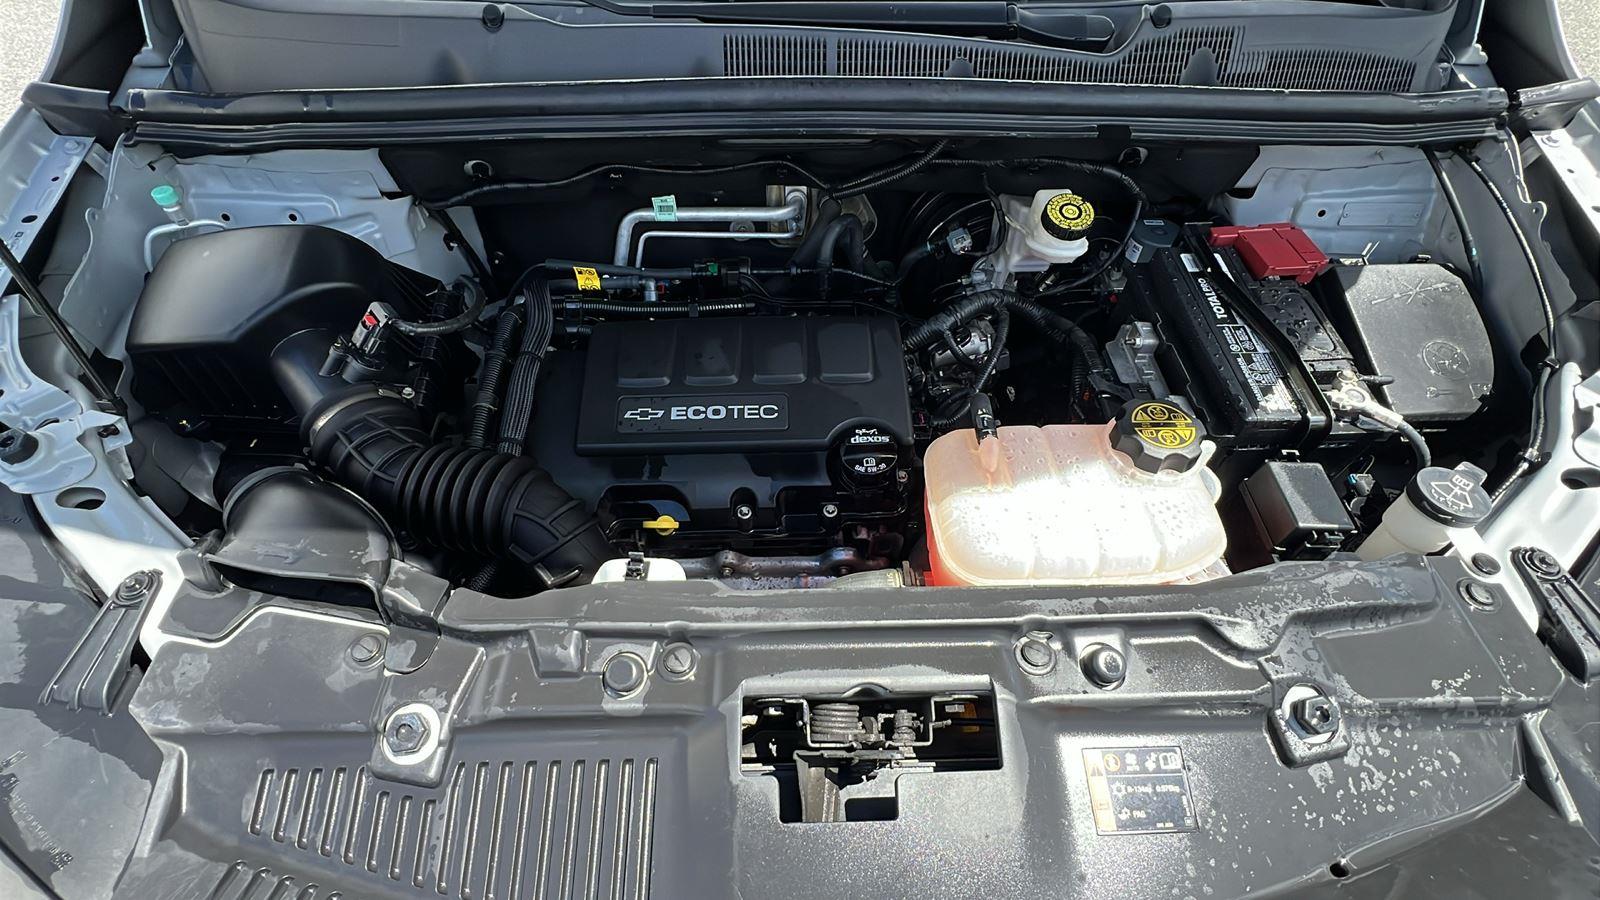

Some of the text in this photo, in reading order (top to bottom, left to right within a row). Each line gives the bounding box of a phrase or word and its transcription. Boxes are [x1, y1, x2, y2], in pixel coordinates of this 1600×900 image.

[670, 404, 779, 419] ECOTEC
[850, 435, 890, 443] dexos
[854, 463, 887, 472] SAE 5W-30
